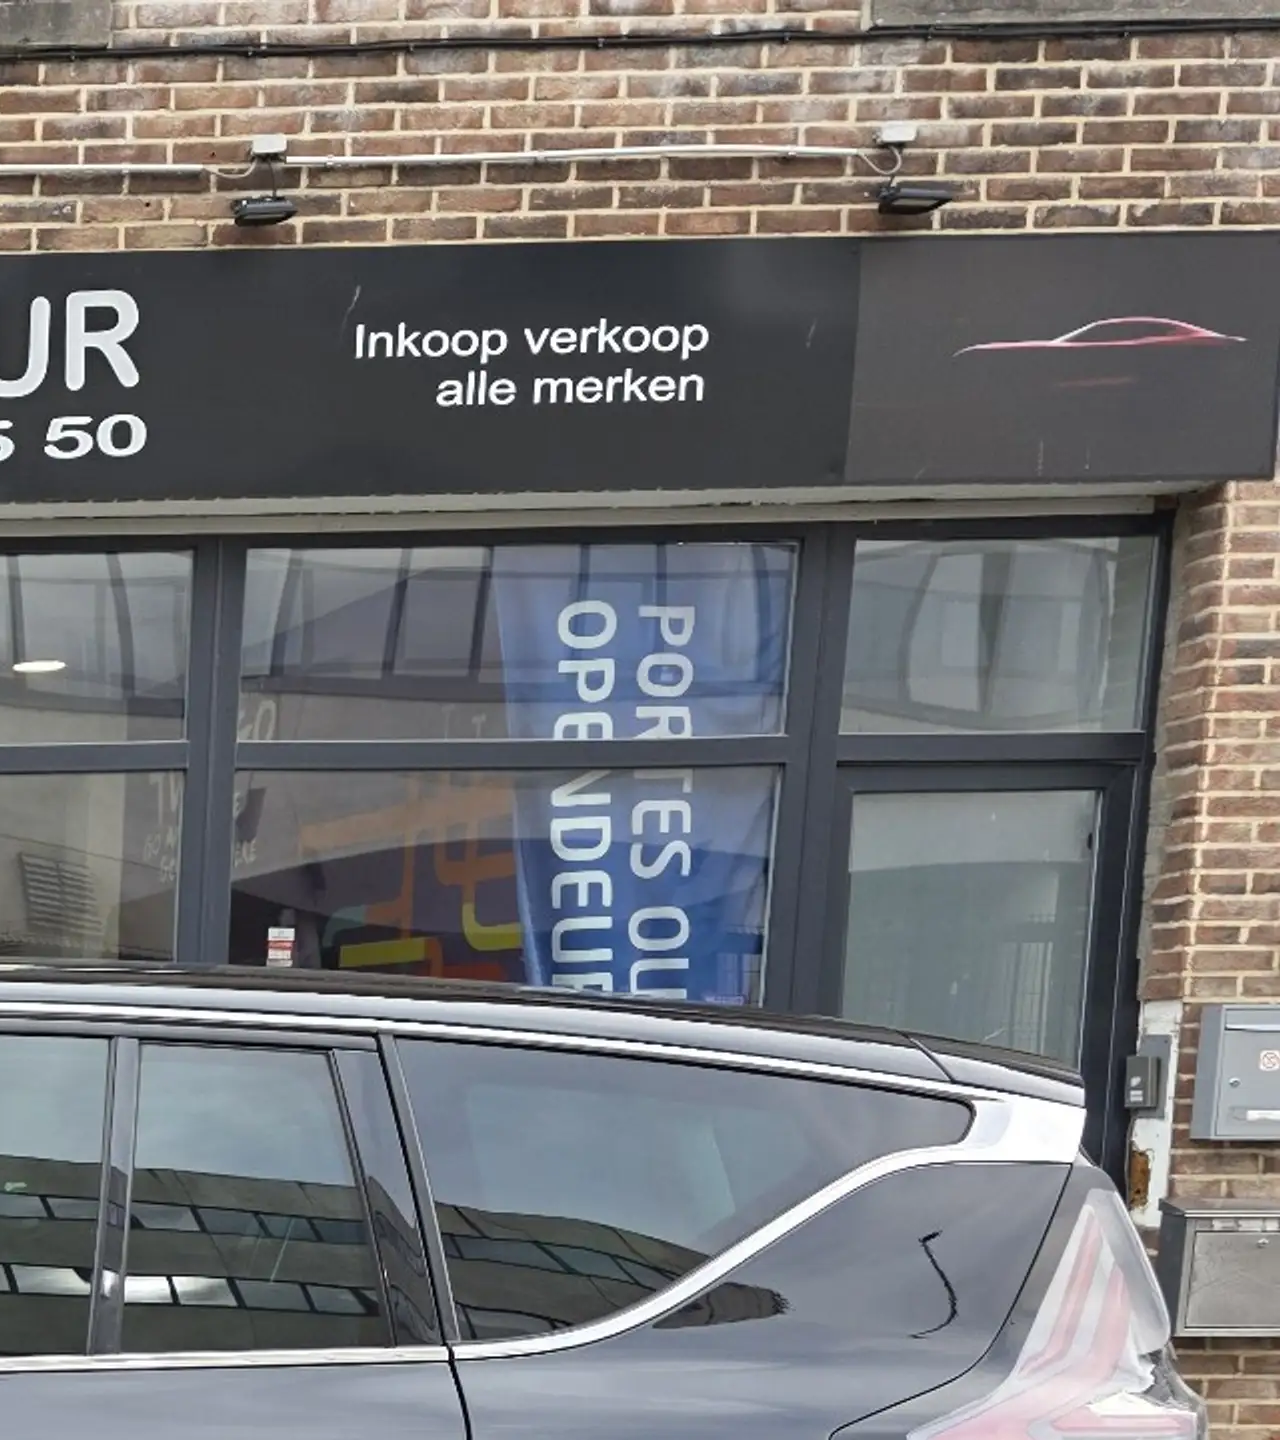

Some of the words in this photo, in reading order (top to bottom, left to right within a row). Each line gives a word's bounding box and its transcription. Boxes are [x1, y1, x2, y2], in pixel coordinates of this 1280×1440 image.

[354, 321, 509, 365] Inkoop
[522, 317, 710, 361] verkoop
[434, 369, 517, 407] alle
[531, 366, 706, 405] merken
[42, 412, 148, 460] 50
